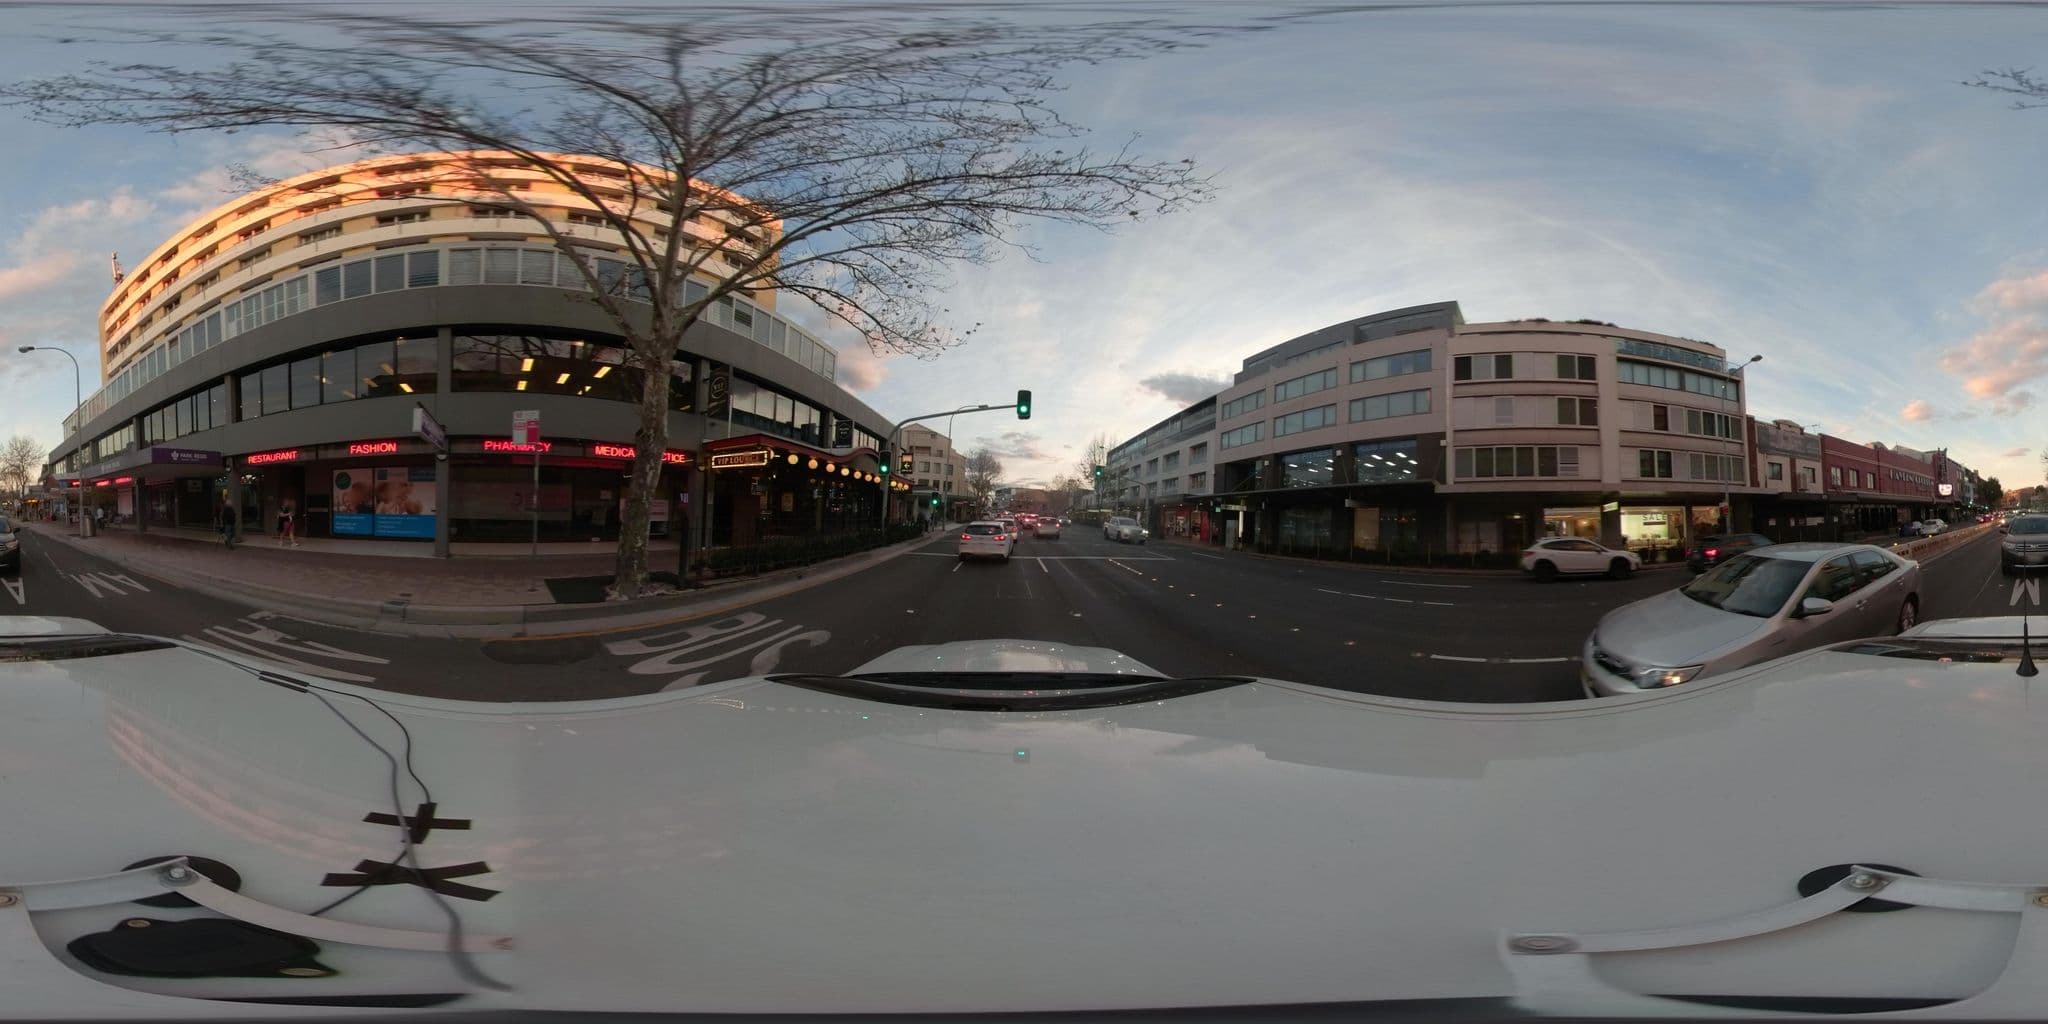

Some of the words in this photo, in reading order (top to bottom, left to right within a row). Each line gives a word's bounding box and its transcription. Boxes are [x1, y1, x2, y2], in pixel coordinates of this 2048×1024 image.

[350, 442, 397, 454] FASHION
[595, 446, 636, 458] MEDICA
[247, 451, 298, 465] RESTAURANT
[717, 457, 729, 465] VIP
[730, 454, 760, 464] LOU
[1642, 513, 1667, 521] SALE
